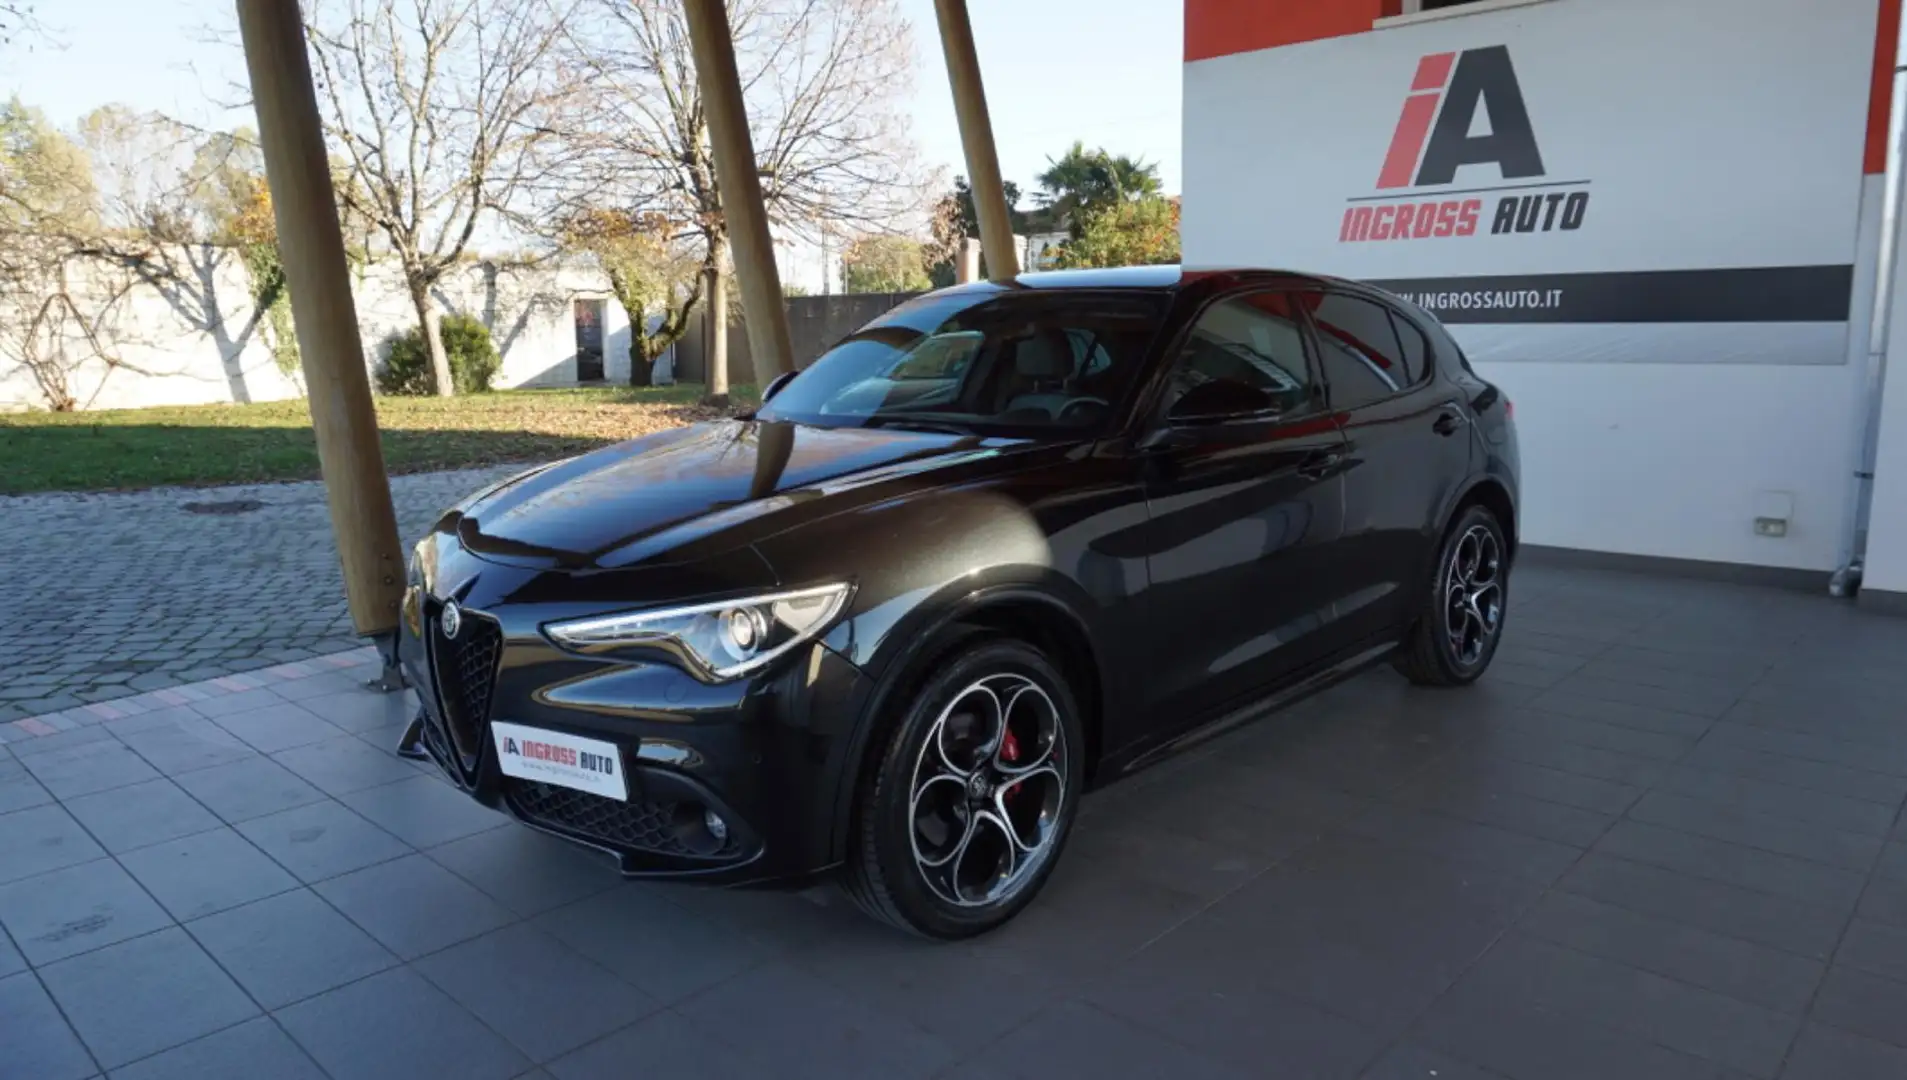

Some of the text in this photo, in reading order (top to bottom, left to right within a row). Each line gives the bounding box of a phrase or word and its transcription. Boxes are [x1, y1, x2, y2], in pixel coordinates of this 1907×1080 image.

[1338, 191, 1590, 242] INGROSS AUTO
[1397, 289, 1563, 309] INGROSSAUTO.IT
[522, 739, 577, 767] INGROSS
[580, 750, 613, 776] AUTO
